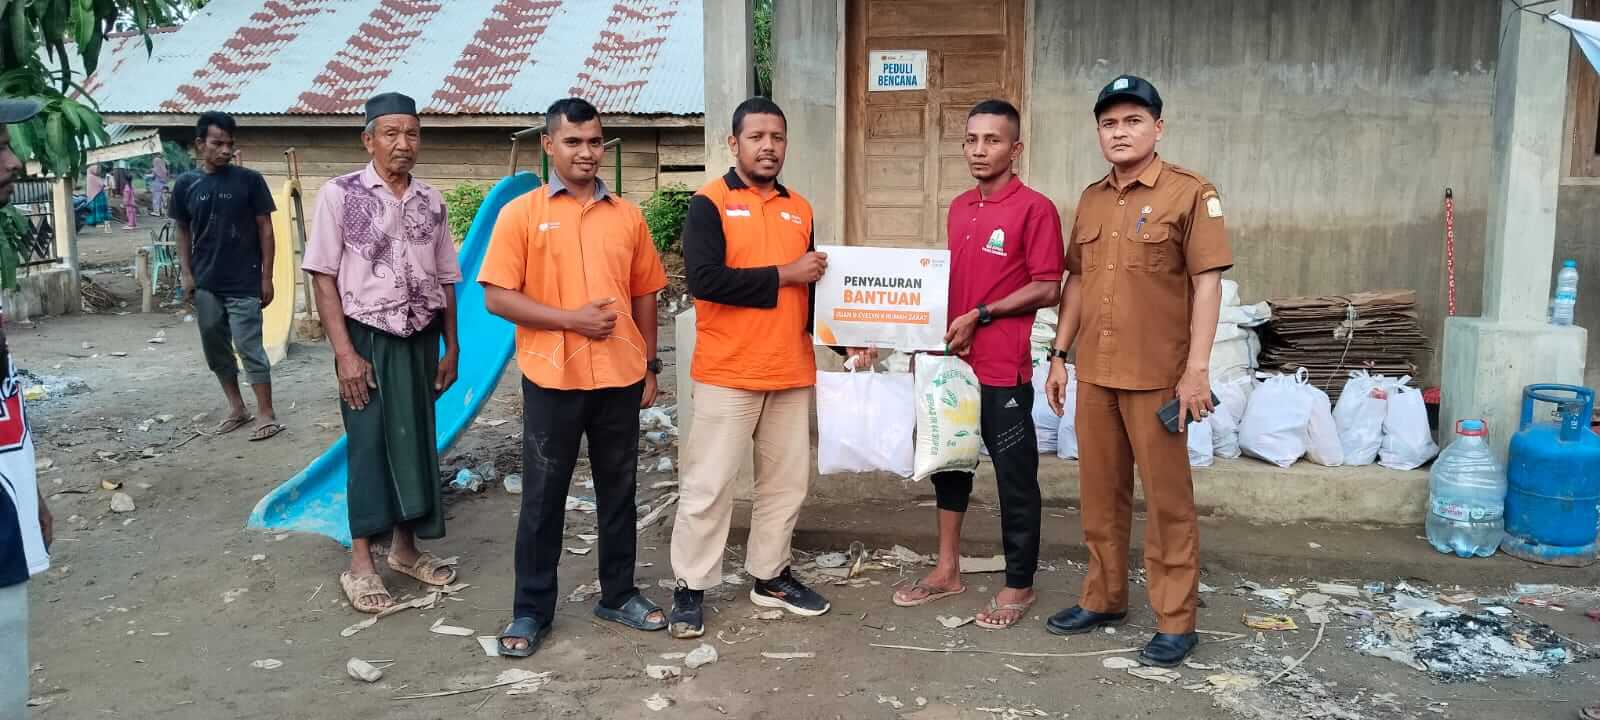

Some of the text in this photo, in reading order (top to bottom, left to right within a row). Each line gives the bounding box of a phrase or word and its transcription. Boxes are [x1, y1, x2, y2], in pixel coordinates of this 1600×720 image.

[883, 63, 913, 74] PEDULI
[878, 75, 918, 86] BENCANA
[844, 276, 922, 288] PENYALURAN
[843, 289, 921, 306] BANTUAN
[930, 433, 941, 456] SUPER
